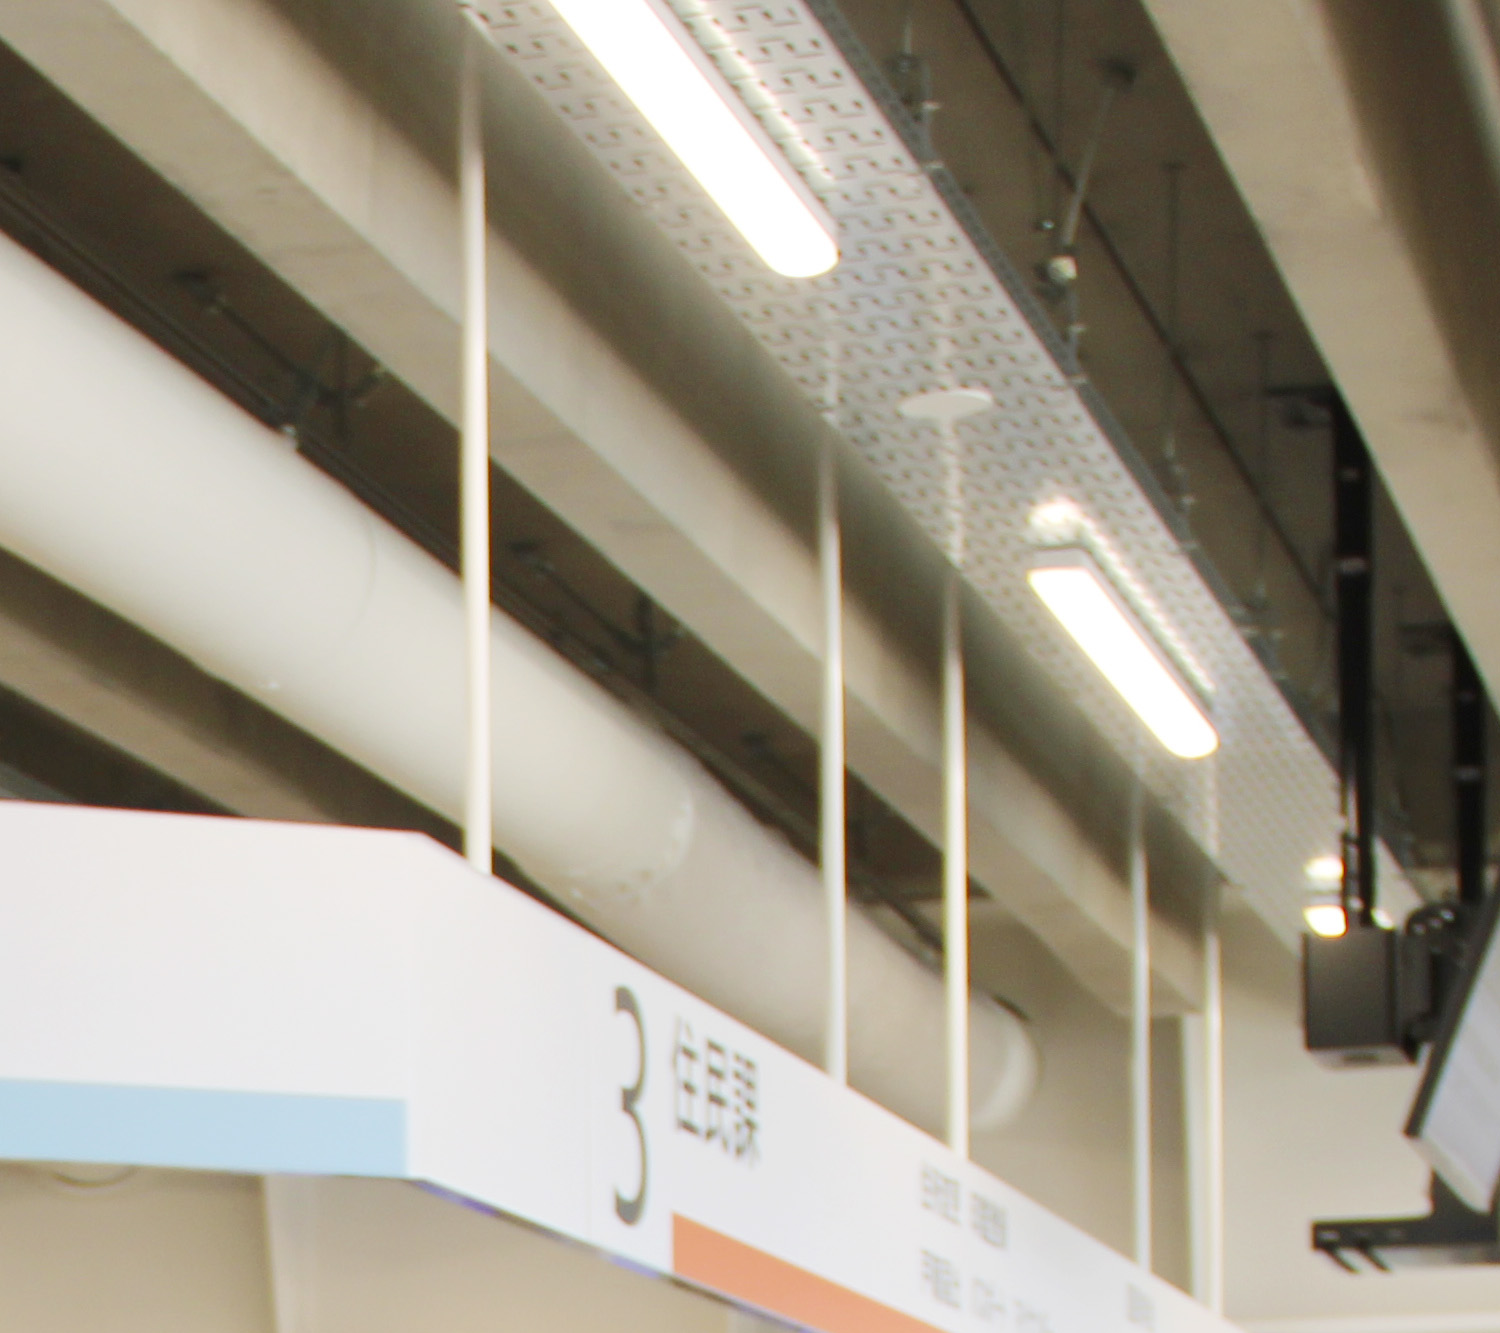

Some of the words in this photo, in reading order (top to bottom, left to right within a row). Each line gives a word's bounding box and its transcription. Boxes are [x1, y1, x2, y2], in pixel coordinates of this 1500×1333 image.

[614, 985, 648, 1225] 3
[674, 1015, 760, 1168] 住民課
